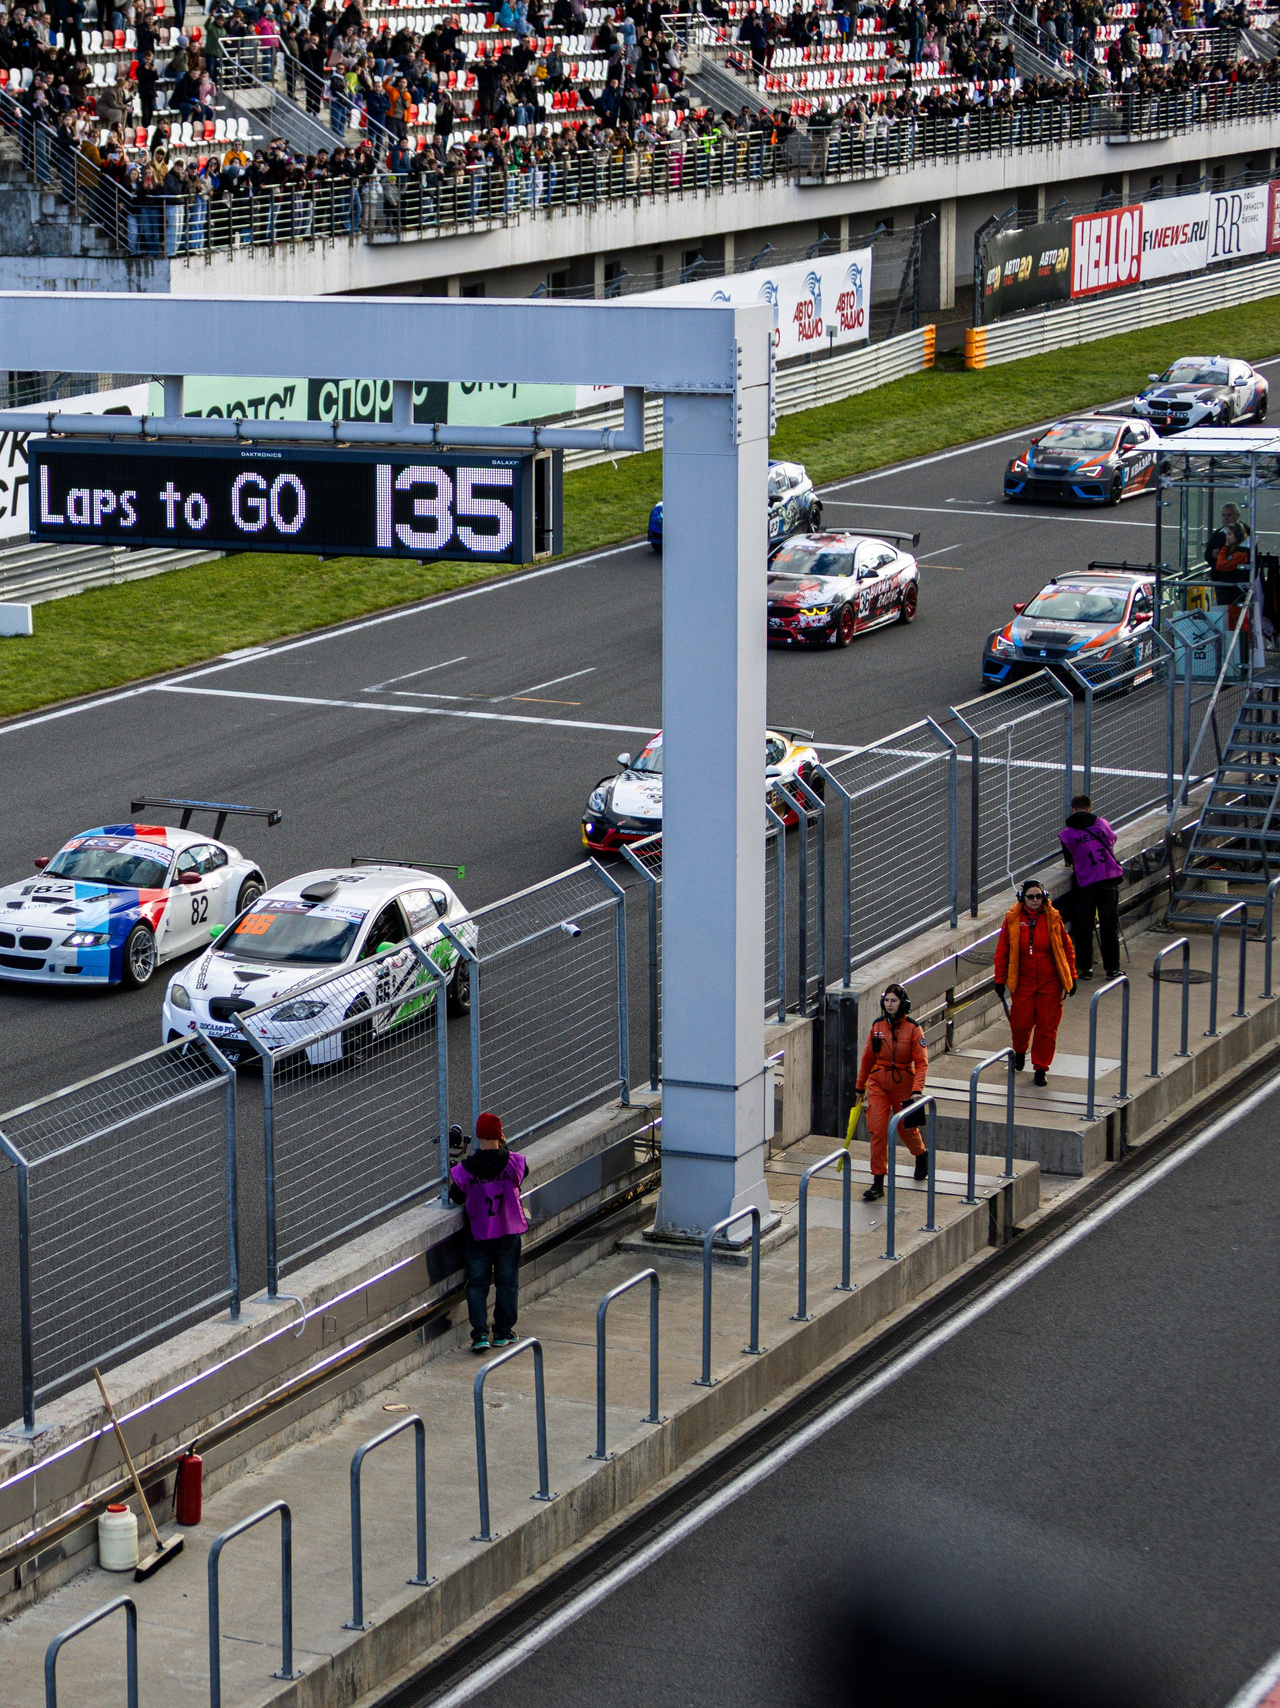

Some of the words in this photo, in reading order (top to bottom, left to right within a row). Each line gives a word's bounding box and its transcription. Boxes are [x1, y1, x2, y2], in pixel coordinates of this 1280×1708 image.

[1143, 219, 1208, 252] F1NEWS.RU
[1212, 194, 1242, 257] RR
[1073, 209, 1140, 292] HELLO!
[792, 299, 814, 324] АВТО
[835, 290, 856, 314] АВТО
[798, 317, 823, 342] РАДИО
[840, 308, 865, 332] РАДИО
[40, 464, 138, 527] Laps
[159, 481, 209, 531] to
[231, 472, 307, 534] GO
[377, 464, 514, 553] 135
[1087, 847, 1106, 866] 13
[33, 885, 75, 894] 82
[191, 896, 210, 926] 82
[235, 913, 276, 936] 66
[485, 1193, 505, 1217] 27
